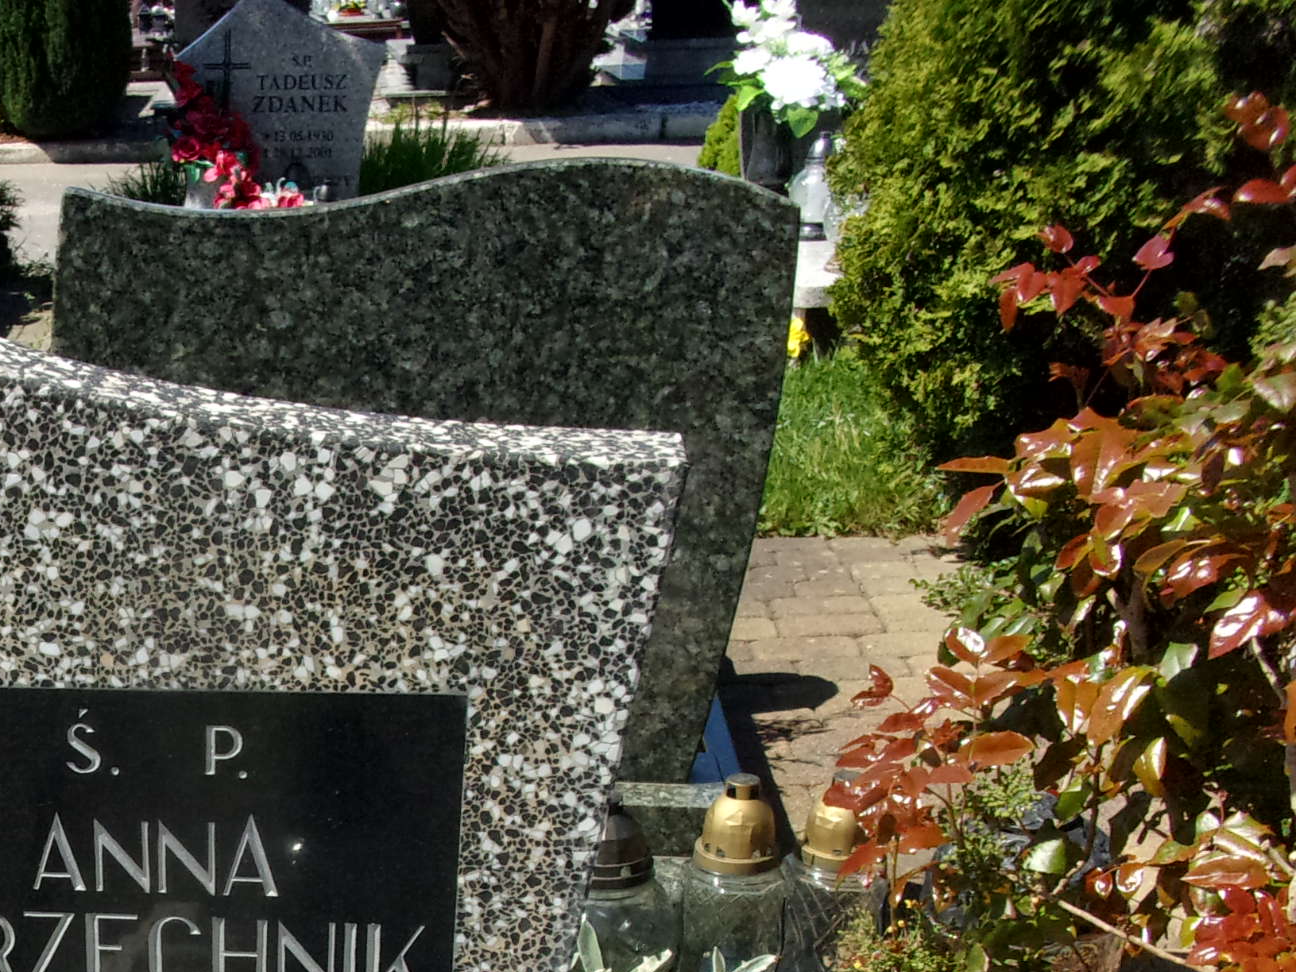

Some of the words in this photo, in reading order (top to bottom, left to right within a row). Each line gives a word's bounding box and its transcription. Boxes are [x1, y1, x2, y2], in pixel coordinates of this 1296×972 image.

[252, 94, 349, 113] ZDANEK
[256, 73, 347, 91] TADEUSZ
[65, 708, 120, 775] Ś.
[204, 724, 248, 779] P.
[33, 812, 279, 898] ANNA
